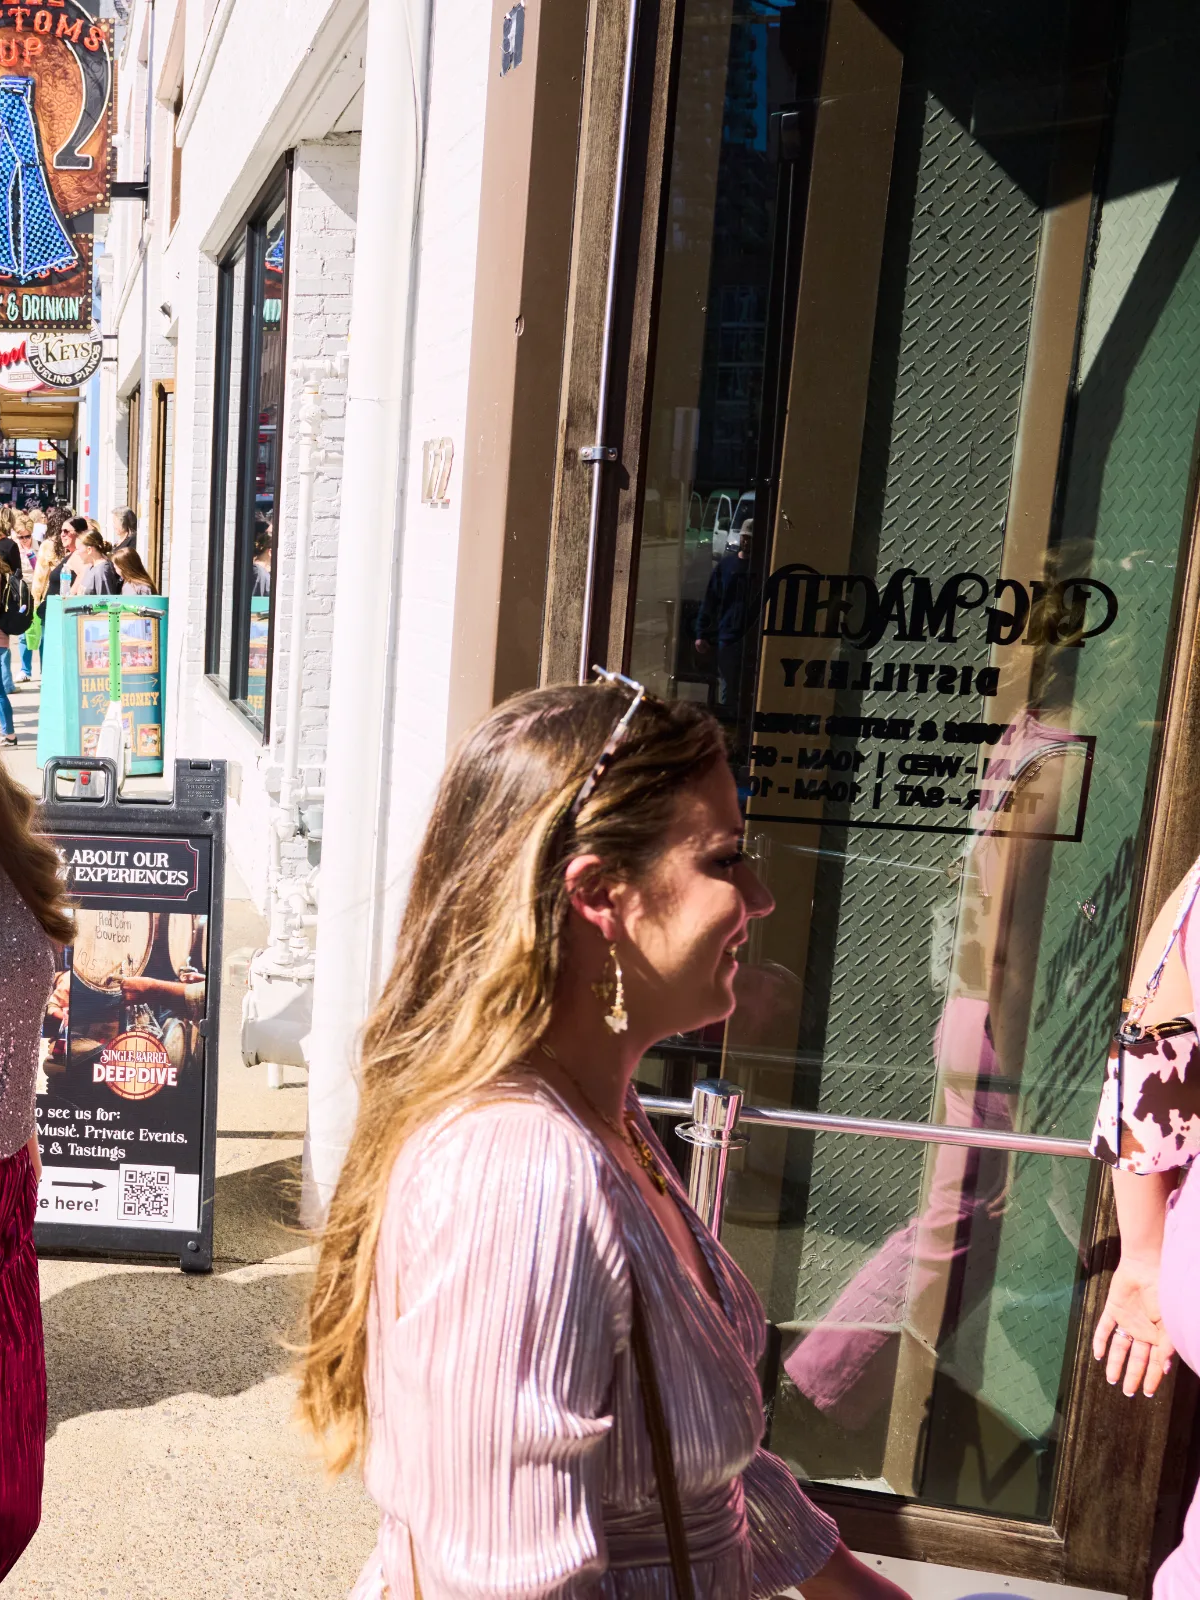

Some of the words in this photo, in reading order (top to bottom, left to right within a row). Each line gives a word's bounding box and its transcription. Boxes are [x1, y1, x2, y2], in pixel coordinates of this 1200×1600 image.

[6, 294, 19, 322] &
[22, 294, 88, 322] DRINKIN'
[44, 339, 91, 362] KEYS
[32, 358, 73, 384] DUELING
[74, 345, 101, 381] PIANOS
[81, 694, 89, 708] A
[70, 849, 128, 866] ABOUT
[133, 852, 169, 868] OUR
[75, 867, 189, 886] EXPERIENCES
[99, 912, 112, 927] Red
[96, 926, 131, 943] Bourbon
[100, 1050, 134, 1064] SINGLE
[135, 1051, 172, 1066] BARREL
[92, 1063, 136, 1083] DEEP
[137, 1067, 178, 1087] DIVE
[47, 1109, 71, 1119] see
[75, 1110, 92, 1121] us
[96, 1108, 121, 1121] for:
[84, 1125, 135, 1142] Private
[49, 1142, 63, 1155] &
[67, 1143, 126, 1161] Tastings
[55, 1196, 99, 1212] here!
